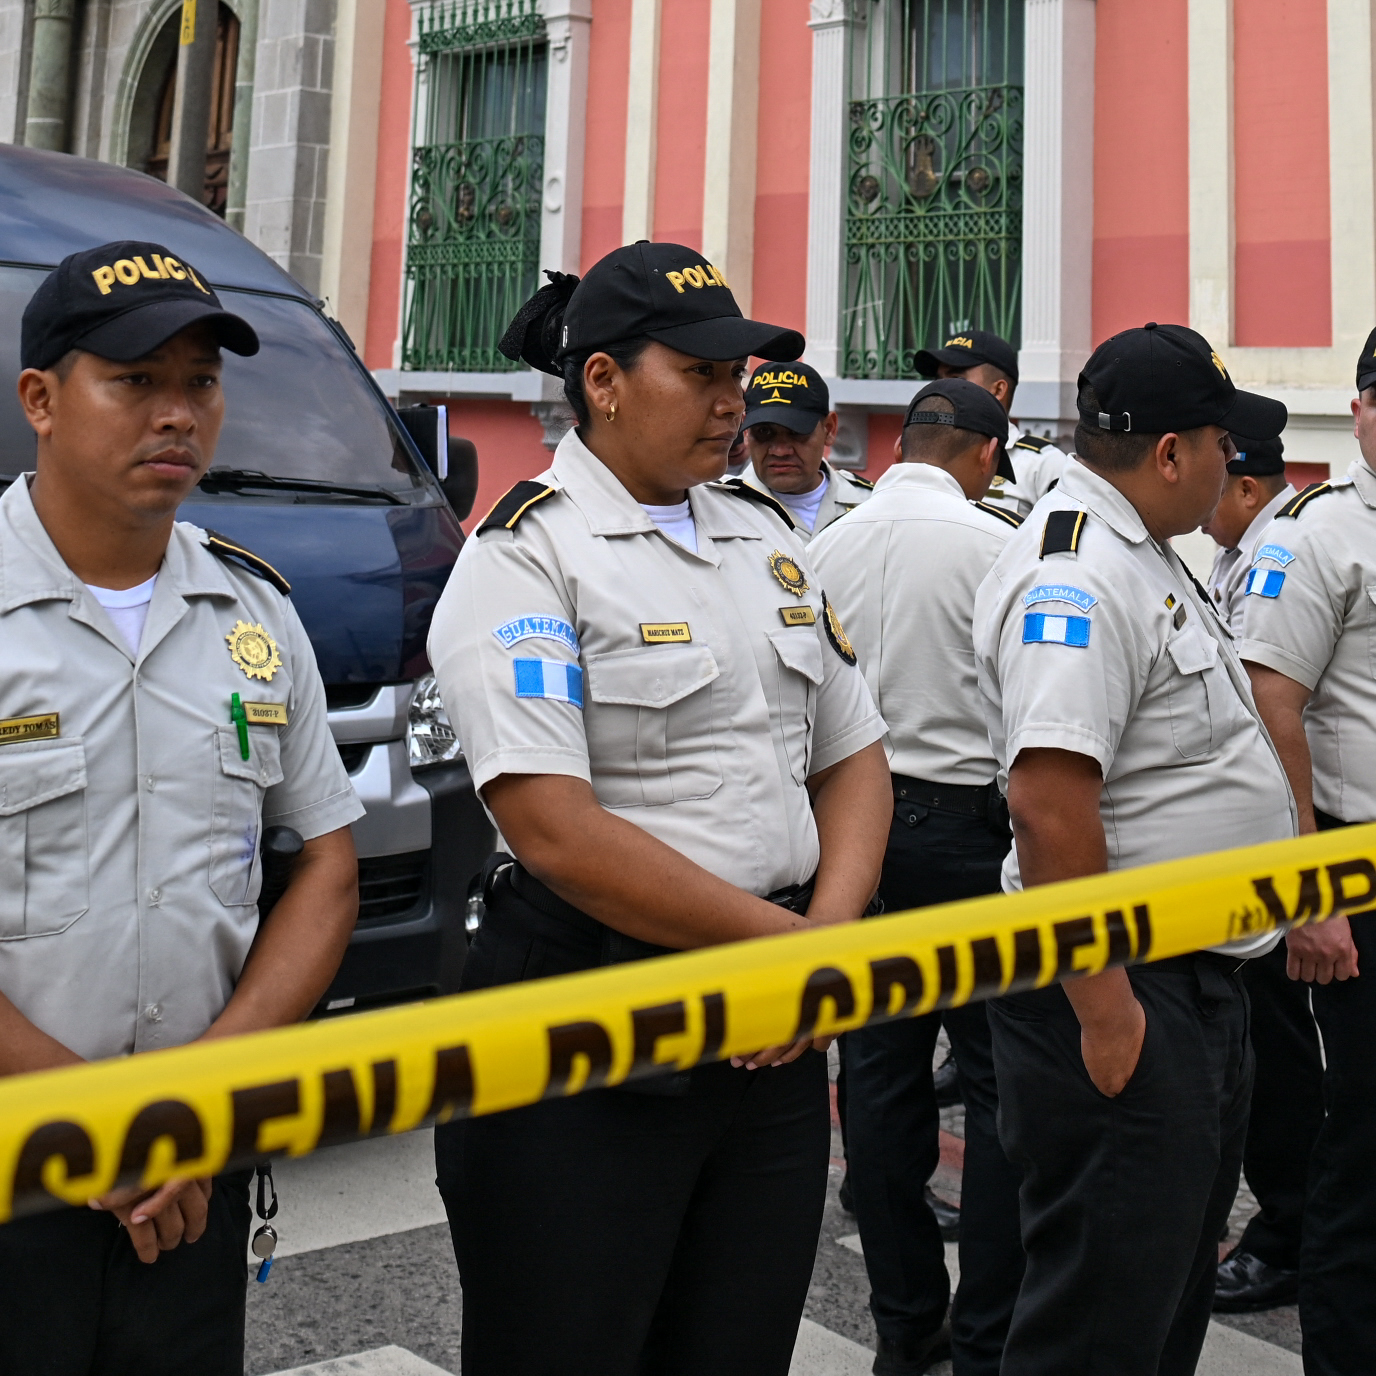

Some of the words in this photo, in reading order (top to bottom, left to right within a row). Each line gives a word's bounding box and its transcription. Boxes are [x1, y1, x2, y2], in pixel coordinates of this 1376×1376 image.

[752, 371, 809, 389] POLICIA
[1026, 588, 1090, 607] GUATEMALA
[23, 720, 56, 733] TOMAS
